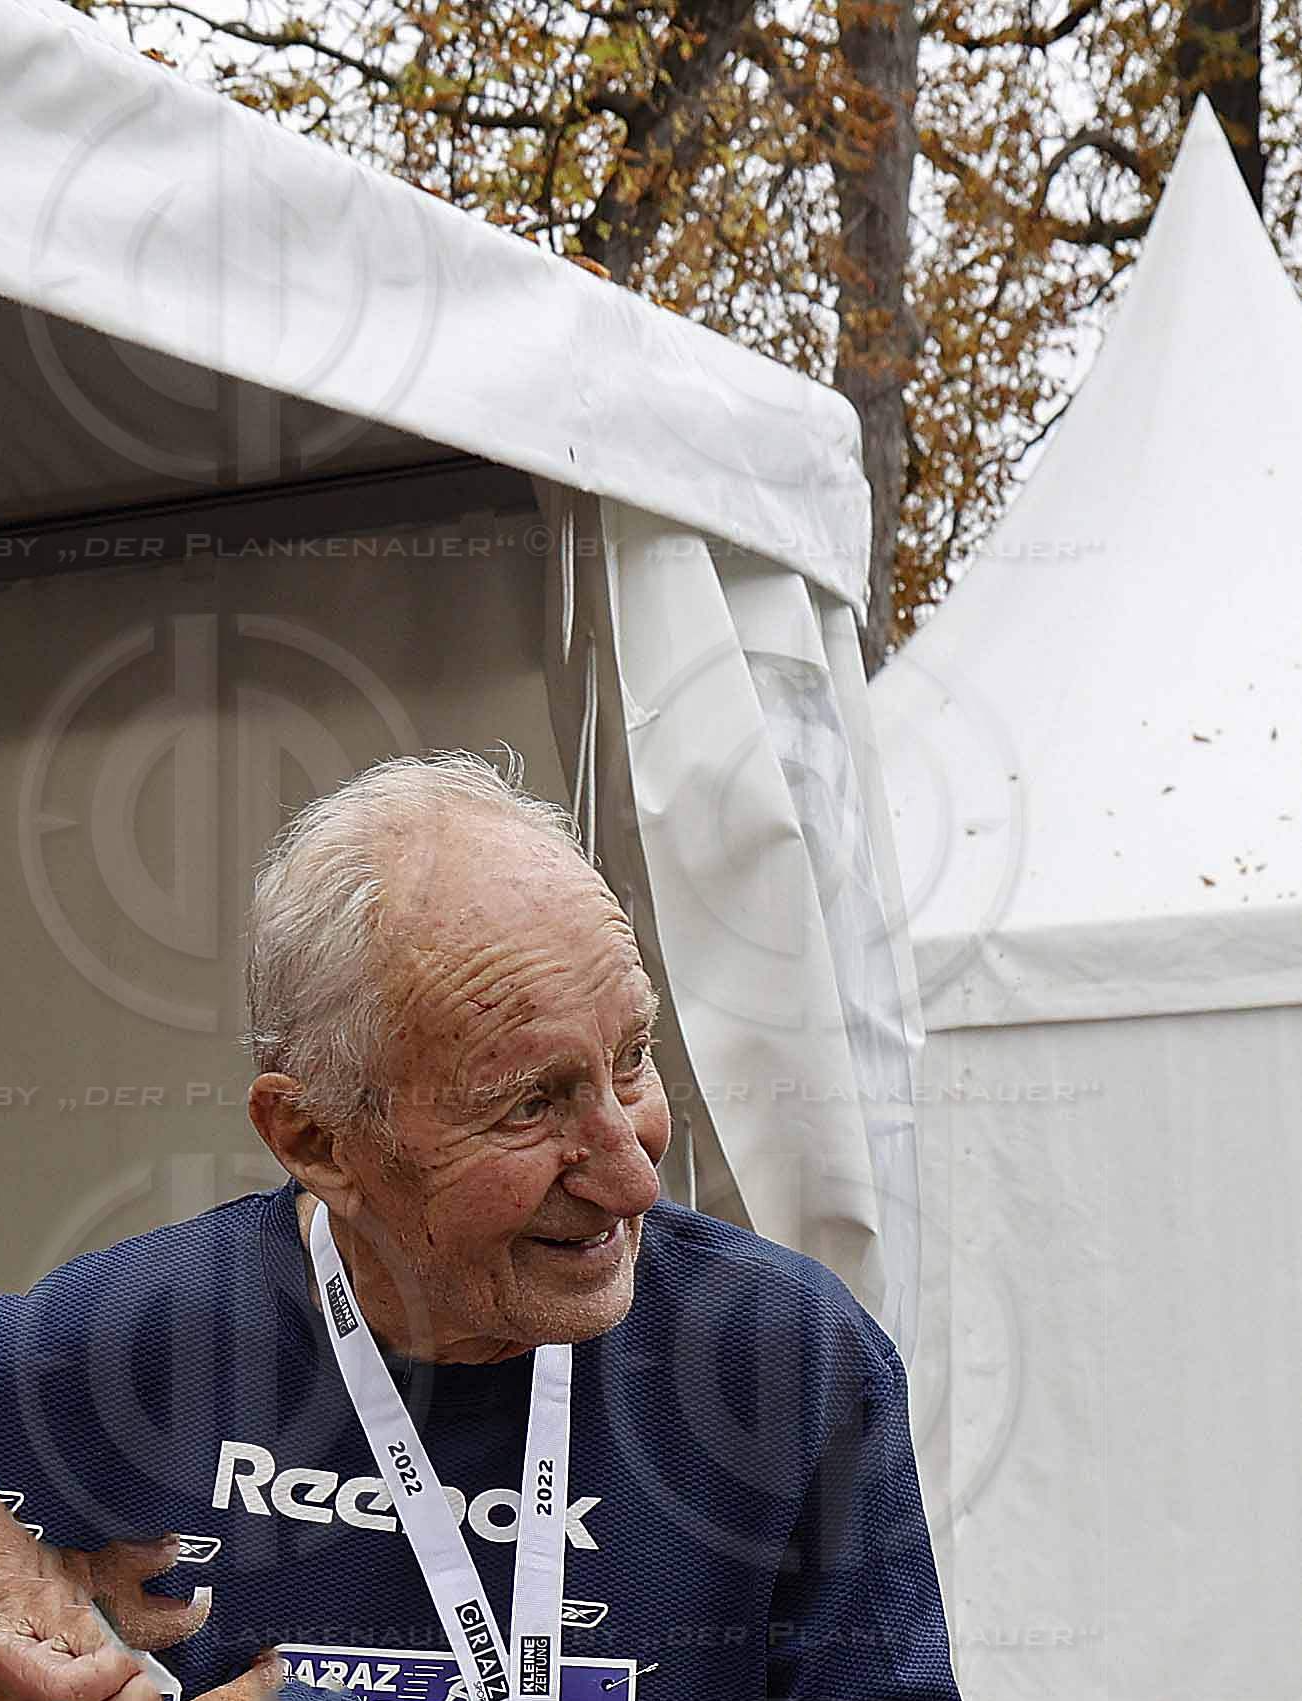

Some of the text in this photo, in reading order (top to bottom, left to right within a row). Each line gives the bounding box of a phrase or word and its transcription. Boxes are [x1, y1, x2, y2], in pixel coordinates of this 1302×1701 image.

[333, 1277, 356, 1329] KLEINE
[387, 1440, 424, 1497] 2022
[536, 1459, 554, 1516] 2022
[459, 1604, 508, 1699] GRAZ
[522, 1638, 536, 1693] KLEINE
[535, 1638, 549, 1693] ZEITUNG
